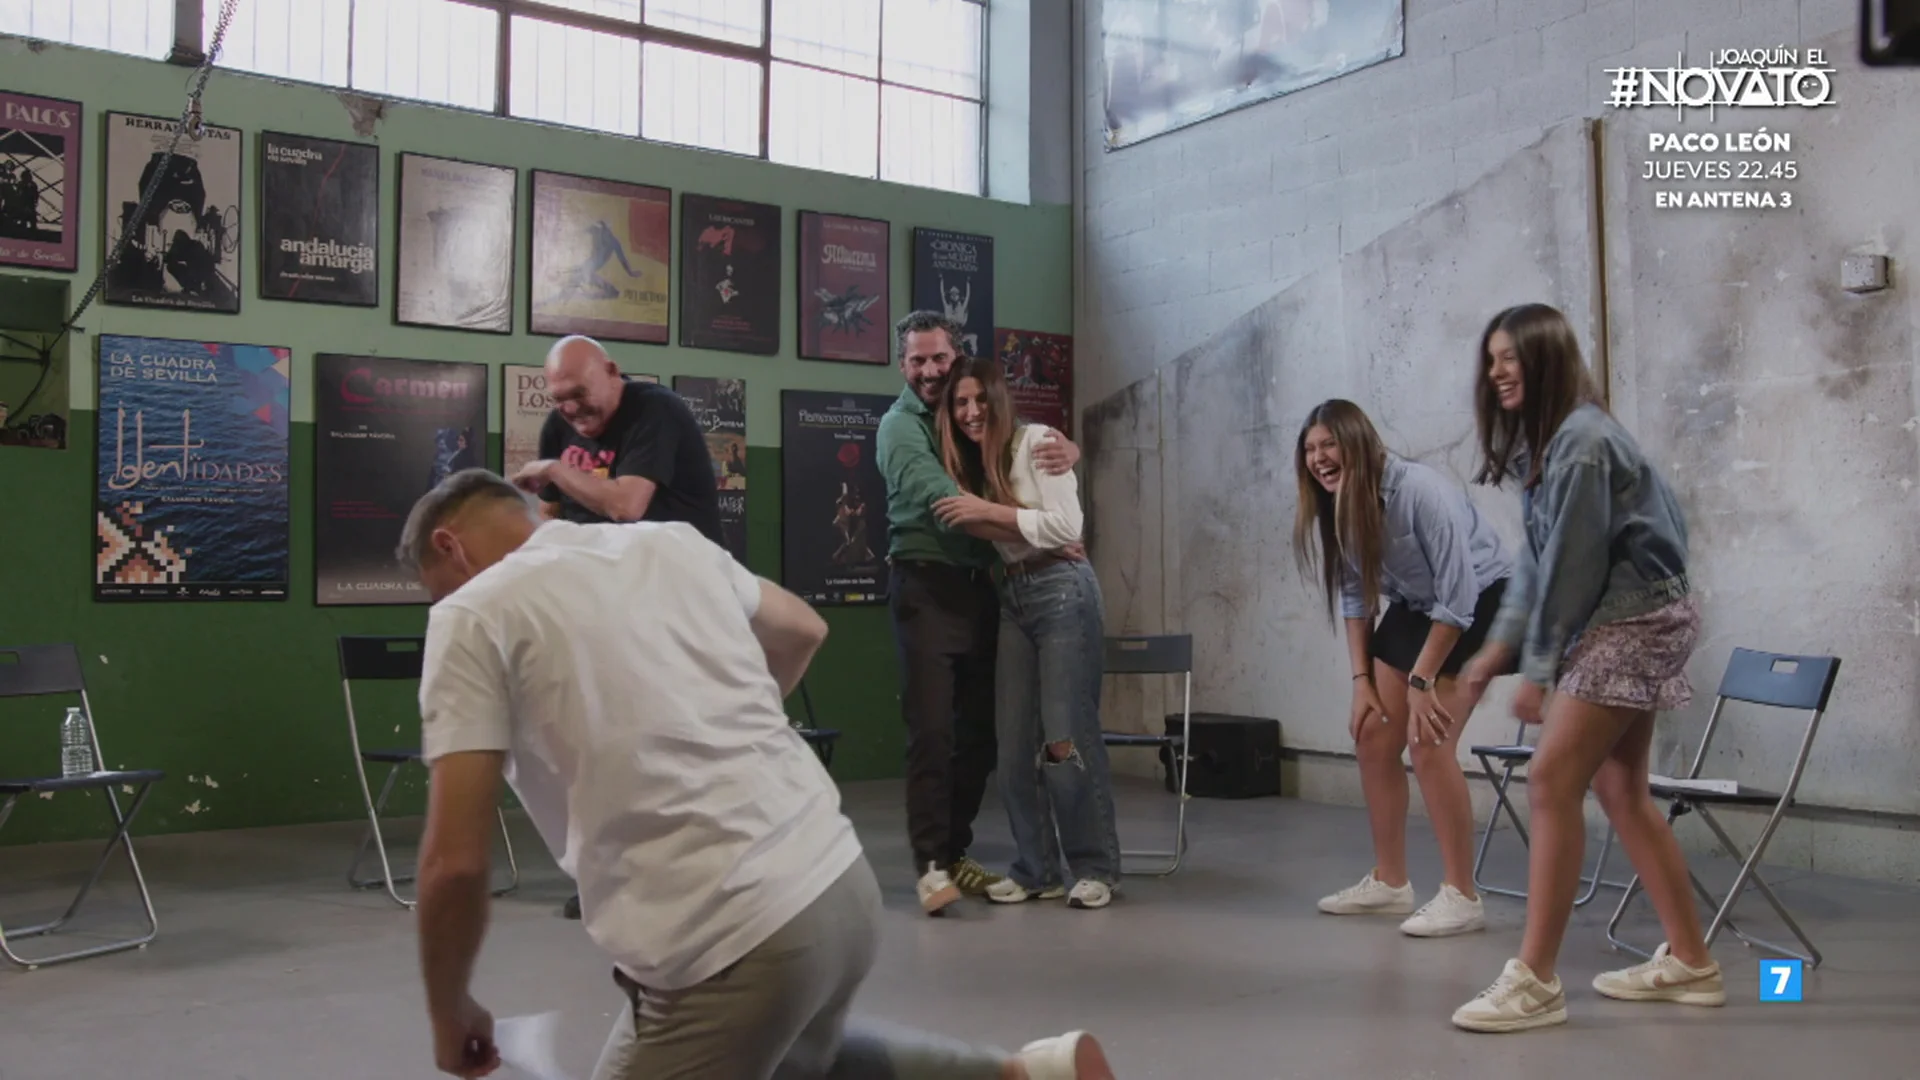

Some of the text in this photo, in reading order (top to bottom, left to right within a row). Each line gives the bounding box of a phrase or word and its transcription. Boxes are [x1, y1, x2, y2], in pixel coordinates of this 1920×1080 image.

[6, 101, 72, 129] PALOS
[125, 117, 231, 140] HERRATAS
[300, 253, 374, 275] amarga
[109, 352, 217, 371] LA CUADRA
[109, 365, 218, 384] DE SEVILLA
[517, 374, 547, 390] DO
[341, 367, 469, 404] Carmen
[355, 582, 404, 592] CUADRA
